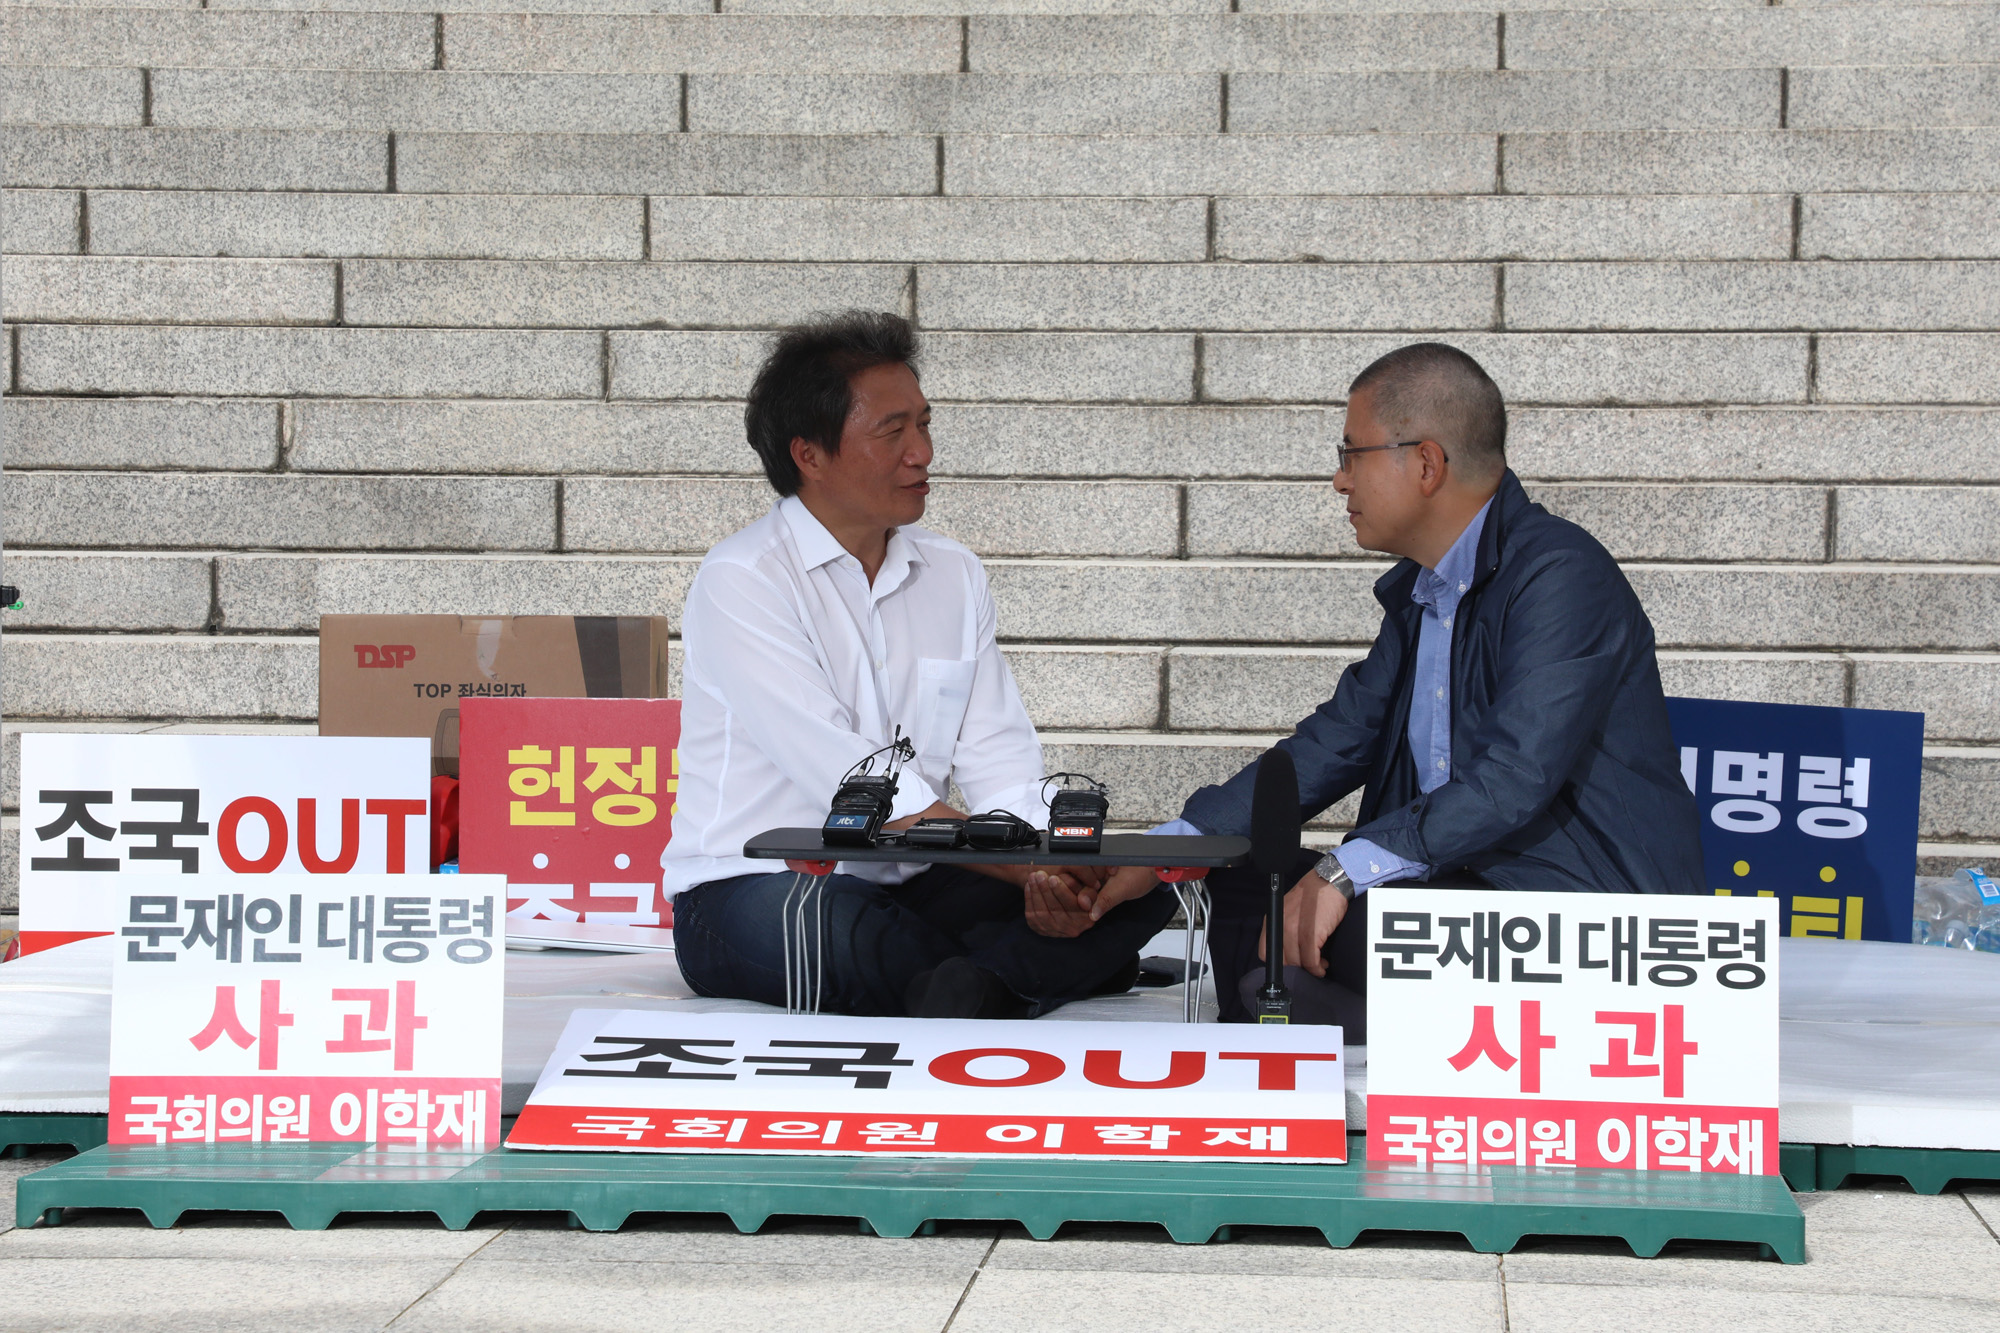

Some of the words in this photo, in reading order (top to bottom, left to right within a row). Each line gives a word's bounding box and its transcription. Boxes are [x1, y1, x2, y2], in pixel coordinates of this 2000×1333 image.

[354, 644, 416, 669] DSP
[413, 683, 452, 698] TOP
[458, 682, 527, 698] 좌식의자
[508, 744, 678, 827] 헌정
[121, 894, 302, 964] 문재인
[317, 896, 494, 964] 대통령
[1374, 911, 1562, 984] 문재인
[1579, 915, 1766, 990] 대통령
[125, 1094, 311, 1142] 국회의원
[329, 1088, 486, 1144] 이학재
[571, 1114, 937, 1147] 국회의원
[985, 1123, 1288, 1151] 이학재
[1383, 1115, 1577, 1168] 국회의원
[1597, 1115, 1763, 1175] 이학재
